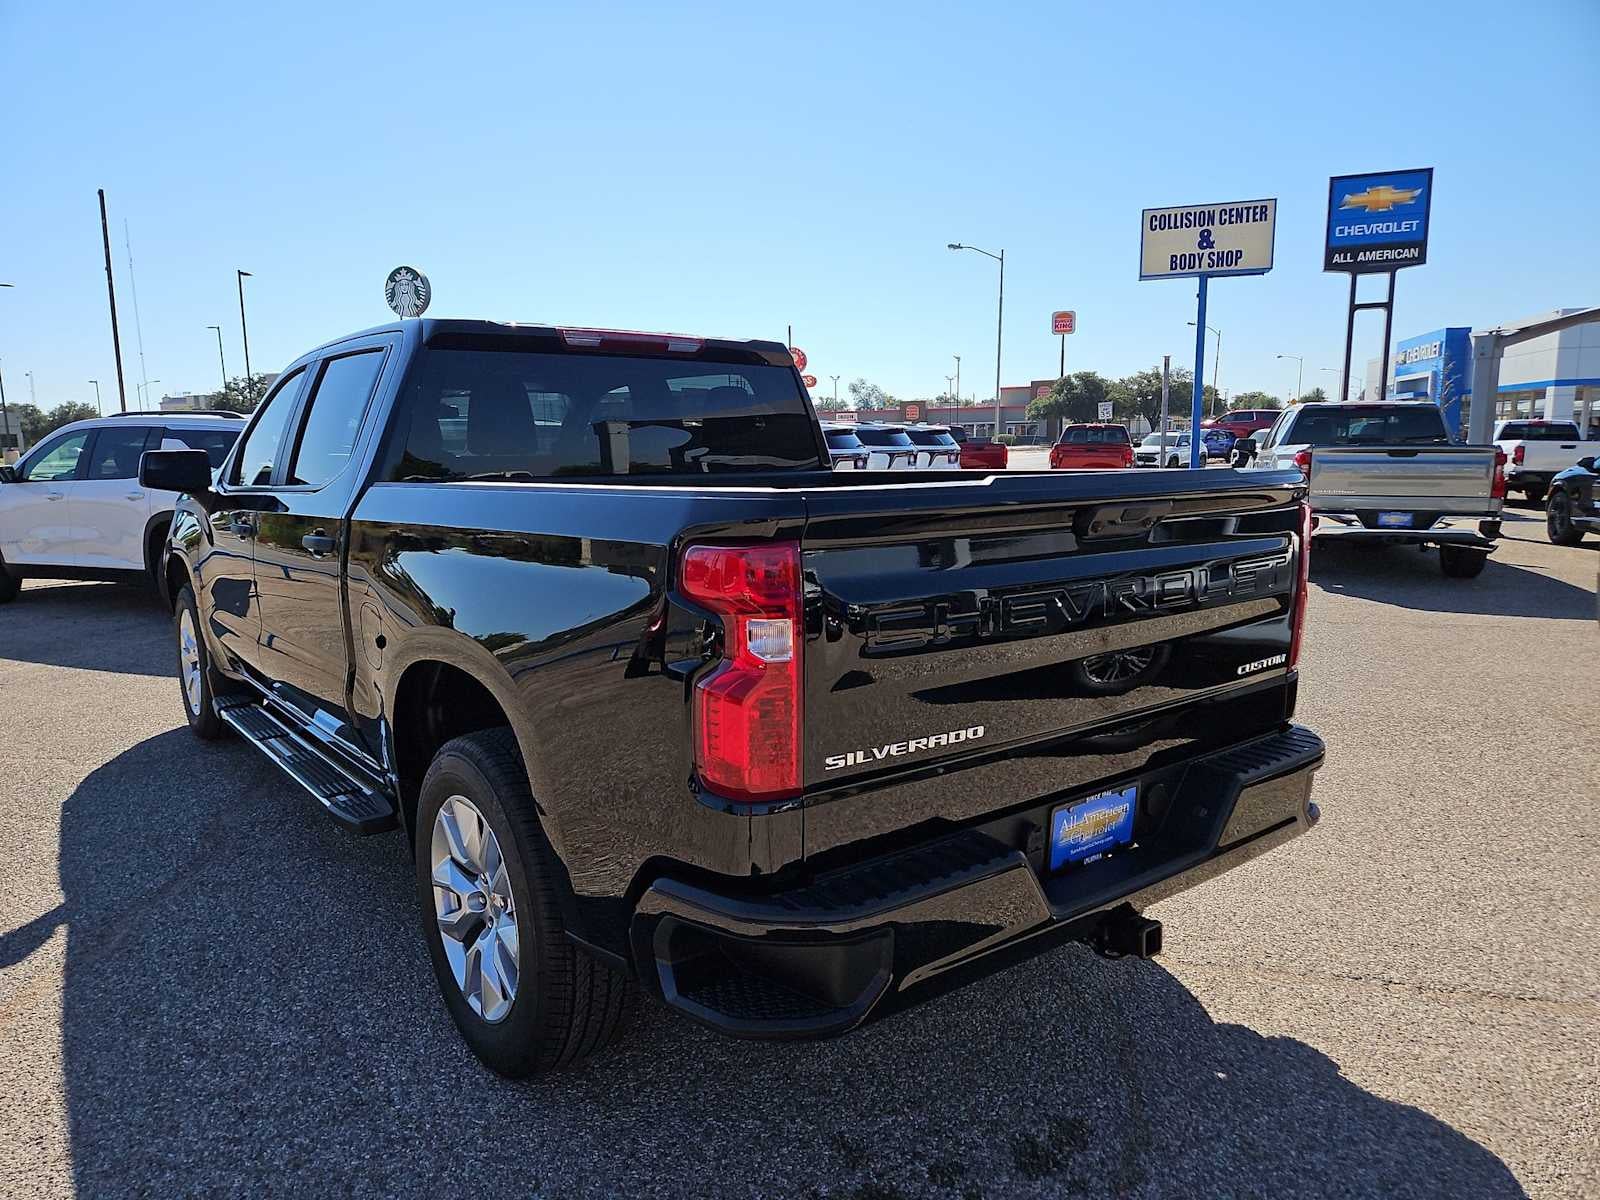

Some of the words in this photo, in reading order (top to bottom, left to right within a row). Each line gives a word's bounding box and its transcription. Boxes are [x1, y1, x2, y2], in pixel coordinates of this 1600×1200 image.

[1149, 209, 1216, 232] COLLISION
[1219, 205, 1268, 226] CENTER
[1335, 220, 1419, 237] CHEVROLET
[1198, 229, 1215, 249] &
[1170, 252, 1205, 271] BODY
[1207, 250, 1243, 268] SHOP
[1332, 253, 1354, 264] ALL
[1357, 247, 1419, 262] AMERICAN
[1406, 341, 1441, 363] CHEVROLET
[862, 554, 1291, 652] CHEVROLET
[1237, 653, 1287, 676] CUSTOM
[824, 725, 985, 771] SILVERADO
[1060, 814, 1078, 833] All
[1082, 802, 1130, 825] American
[1070, 820, 1117, 845] Chevrolet
